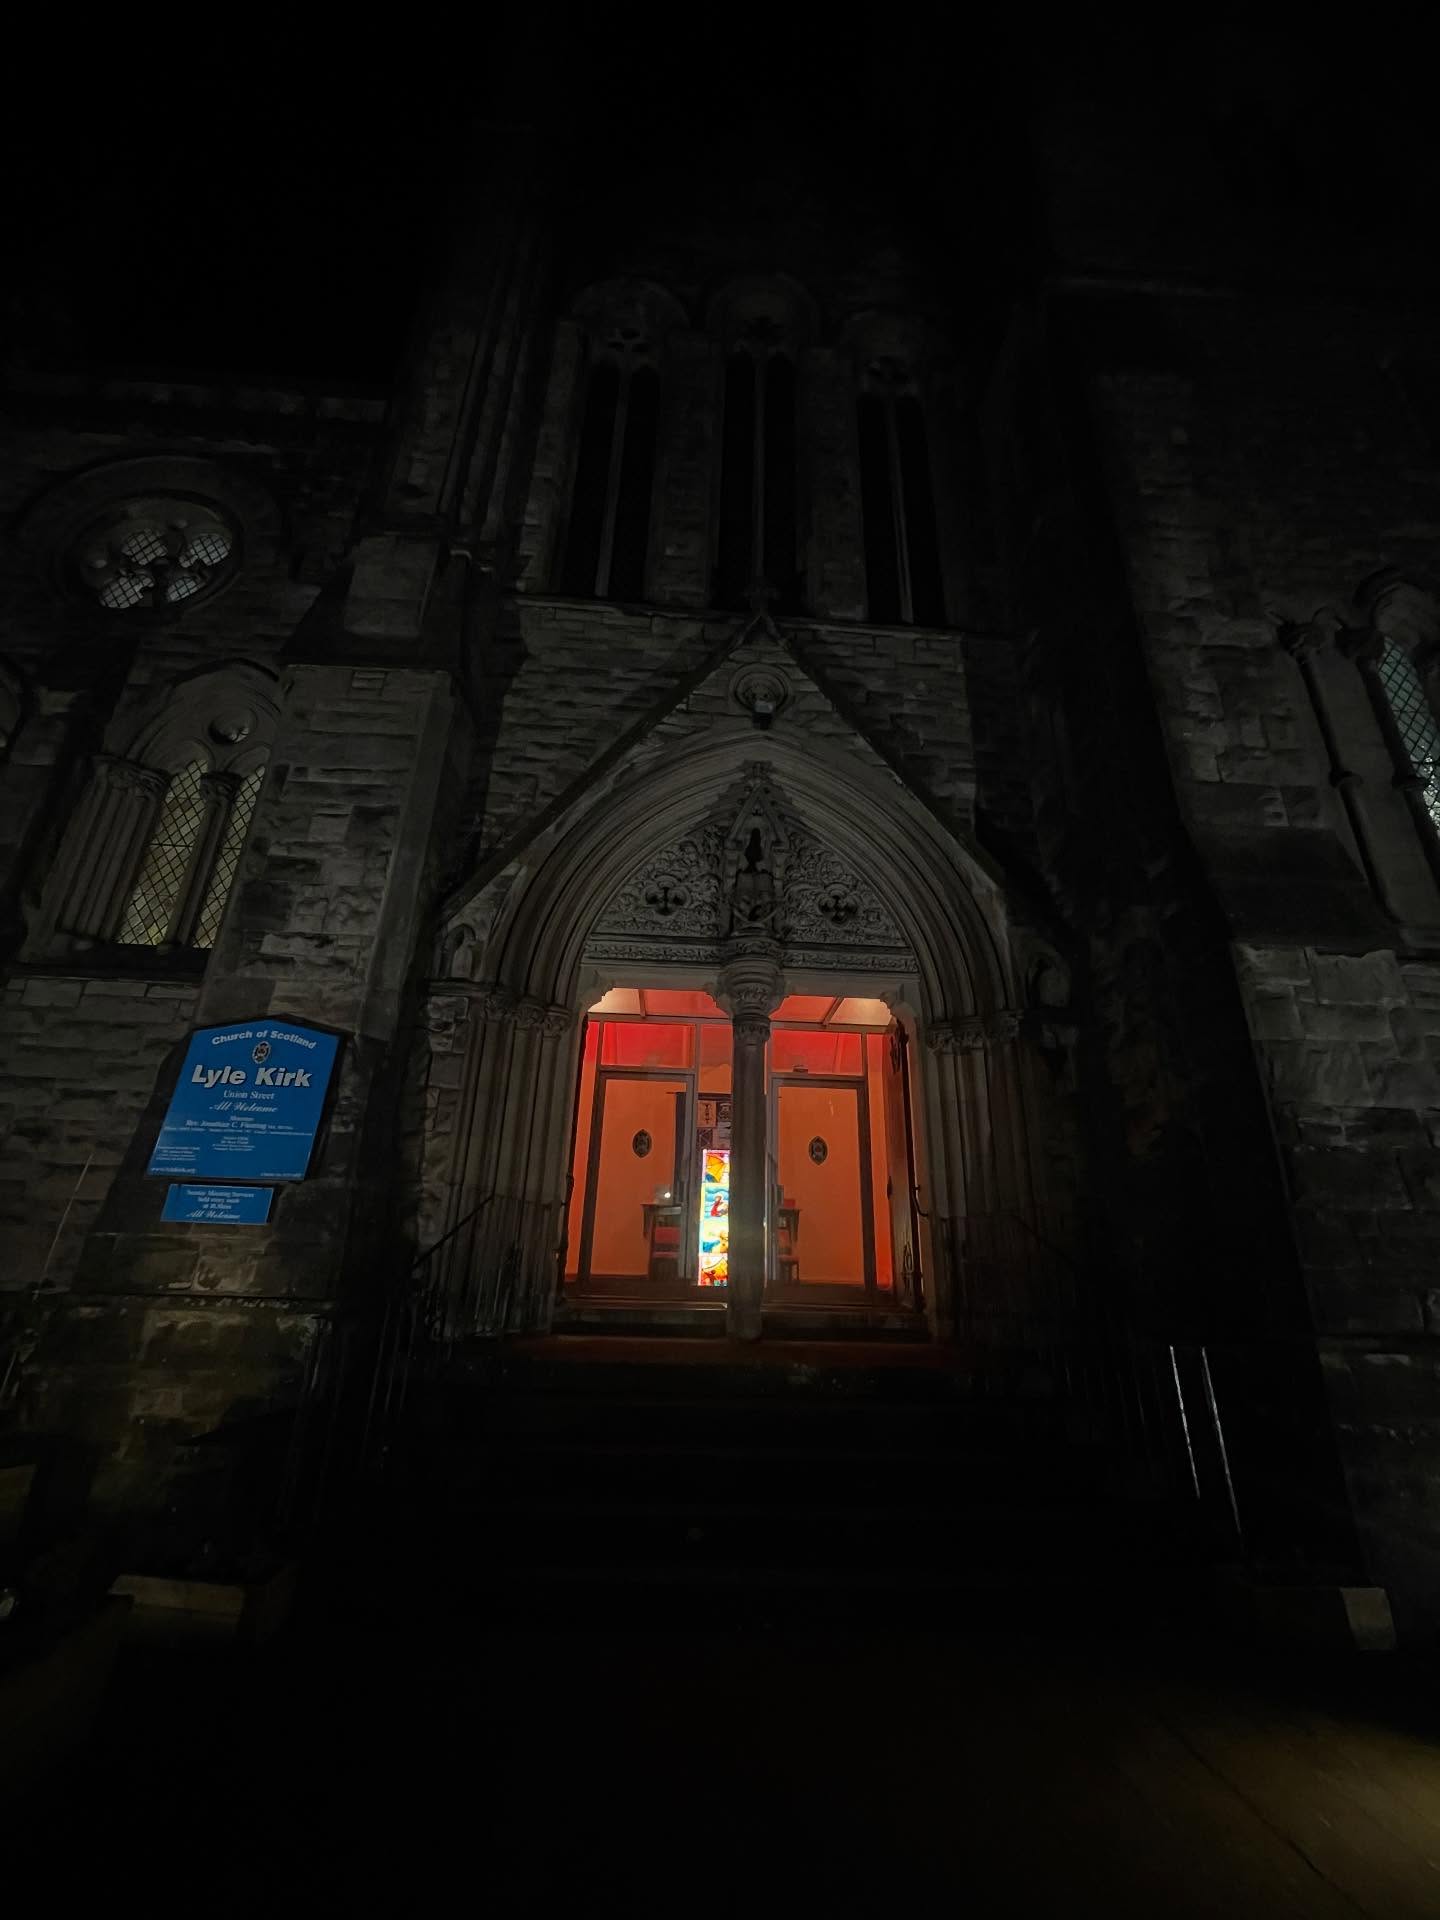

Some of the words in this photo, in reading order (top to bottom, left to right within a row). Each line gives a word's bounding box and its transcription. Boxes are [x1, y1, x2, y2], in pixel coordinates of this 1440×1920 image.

[212, 1030, 252, 1045] Church
[256, 1030, 268, 1038] of
[270, 1030, 317, 1049] Scotland
[191, 1064, 246, 1088] Lyle
[254, 1067, 312, 1087] Kirk
[223, 1090, 248, 1099] Union
[250, 1091, 275, 1099] Street
[209, 1101, 232, 1111] All
[234, 1102, 278, 1113] Welcome
[186, 1209, 204, 1218] All
